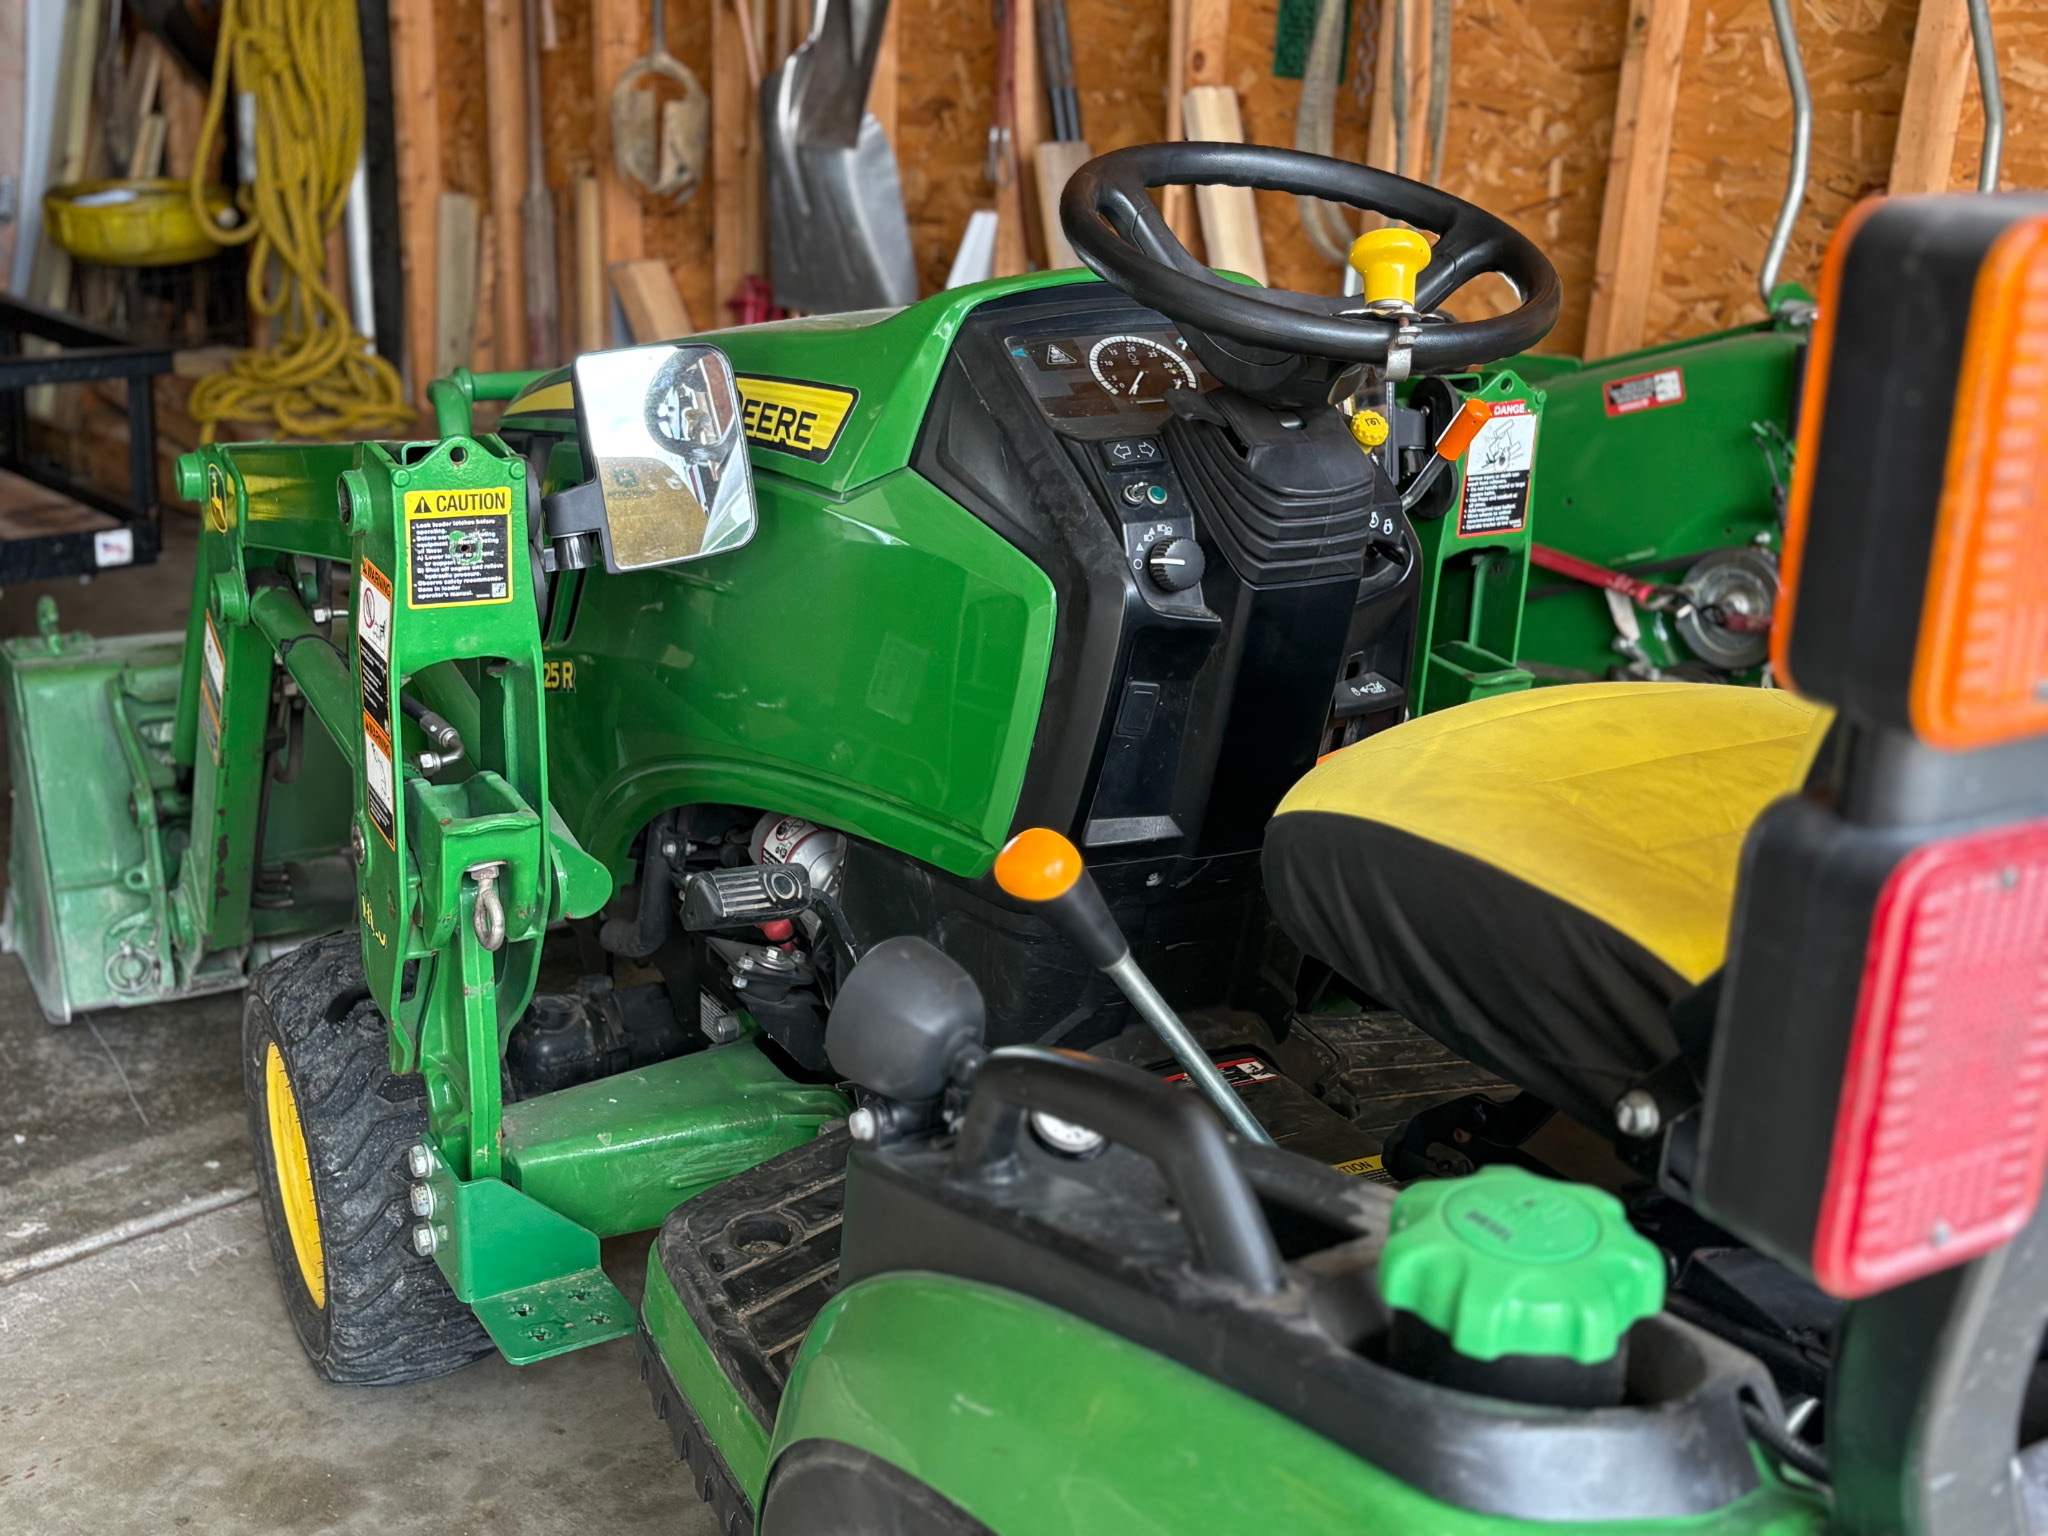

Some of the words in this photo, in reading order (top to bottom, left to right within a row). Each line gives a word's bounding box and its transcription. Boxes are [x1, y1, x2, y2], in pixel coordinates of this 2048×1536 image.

[739, 394, 818, 445] EERE
[1494, 404, 1529, 415] DANGE
[436, 492, 505, 513] CAUTION
[368, 563, 390, 597] WARNING
[1338, 1161, 1373, 1173] TION
